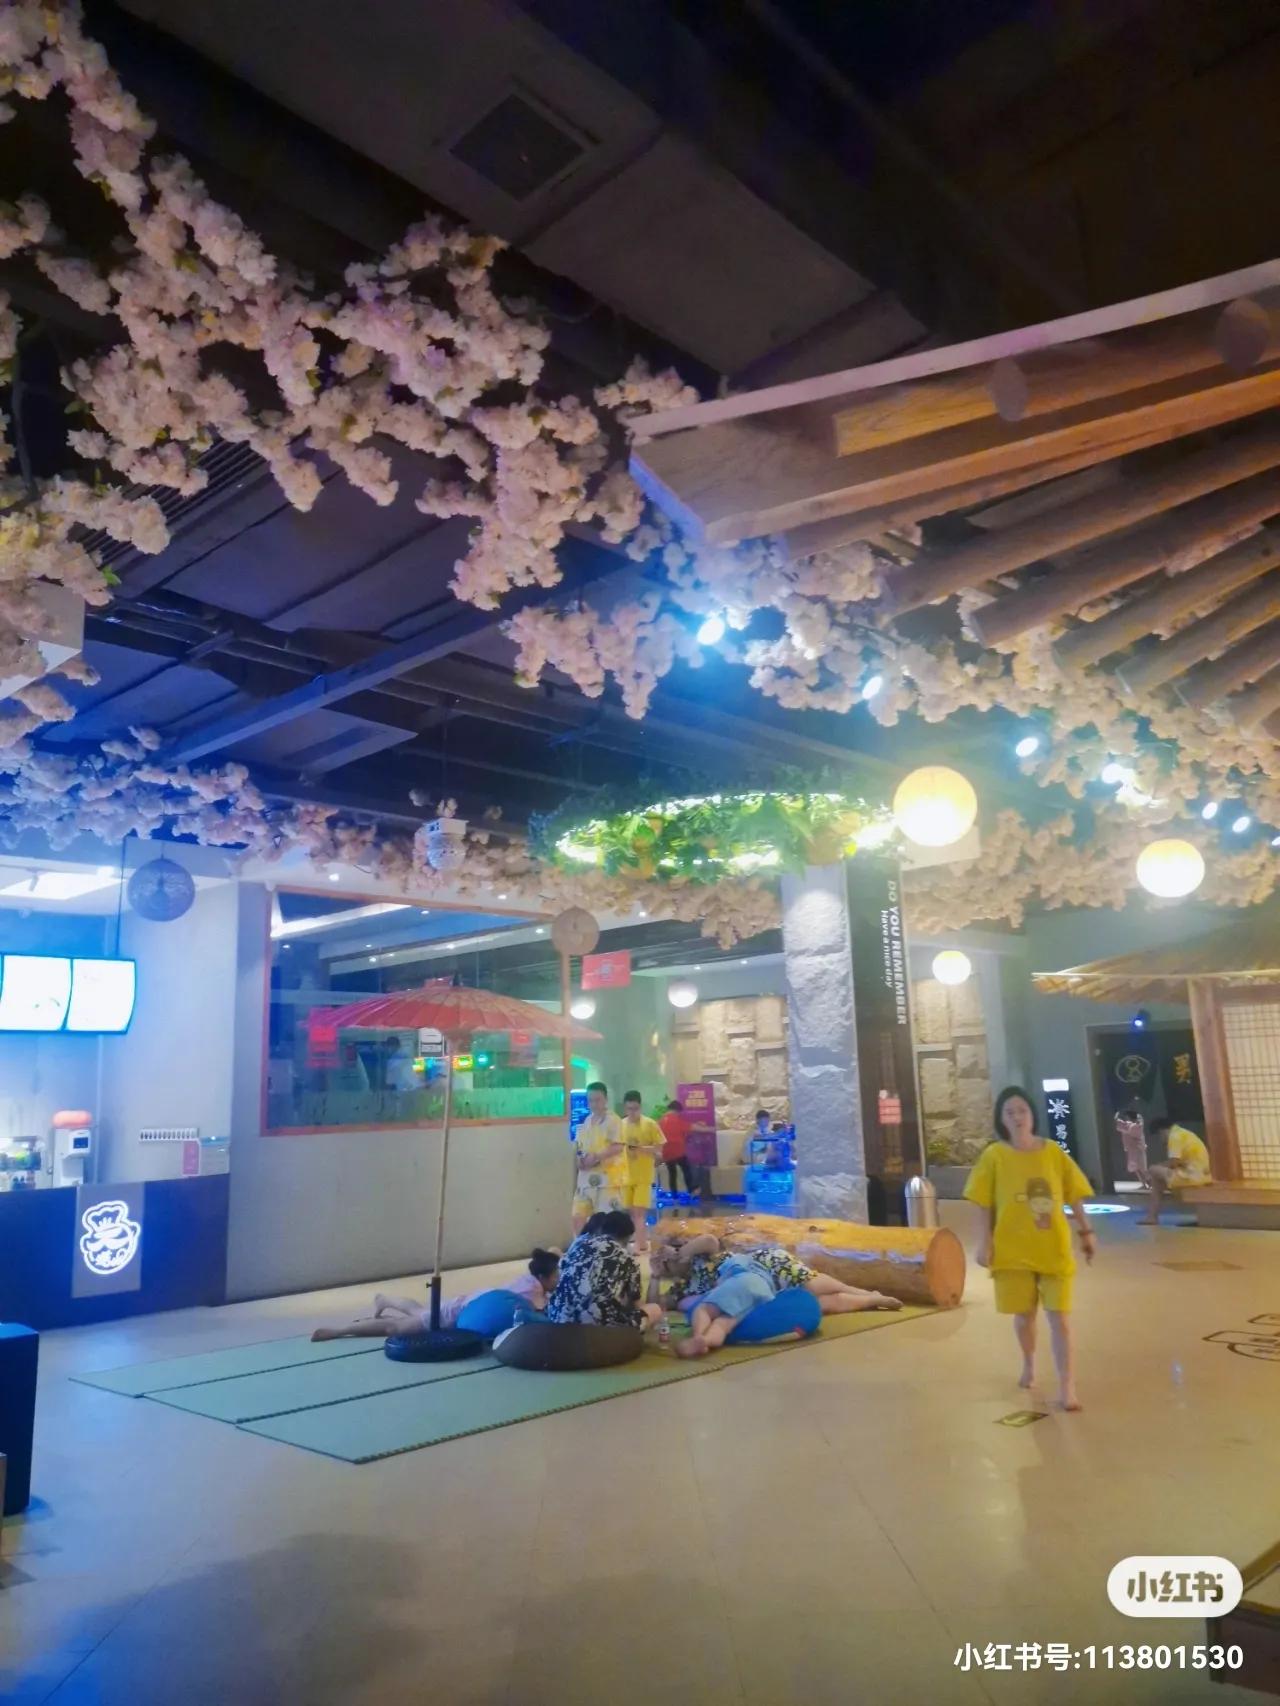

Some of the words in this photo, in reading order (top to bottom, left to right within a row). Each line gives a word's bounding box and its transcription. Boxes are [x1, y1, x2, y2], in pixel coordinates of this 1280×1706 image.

[888, 880, 898, 902] DO
[881, 910, 889, 936] Have
[889, 906, 901, 937] YOU
[883, 945, 891, 967] nice
[885, 967, 893, 988] day
[892, 940, 907, 1024] REMEMBER
